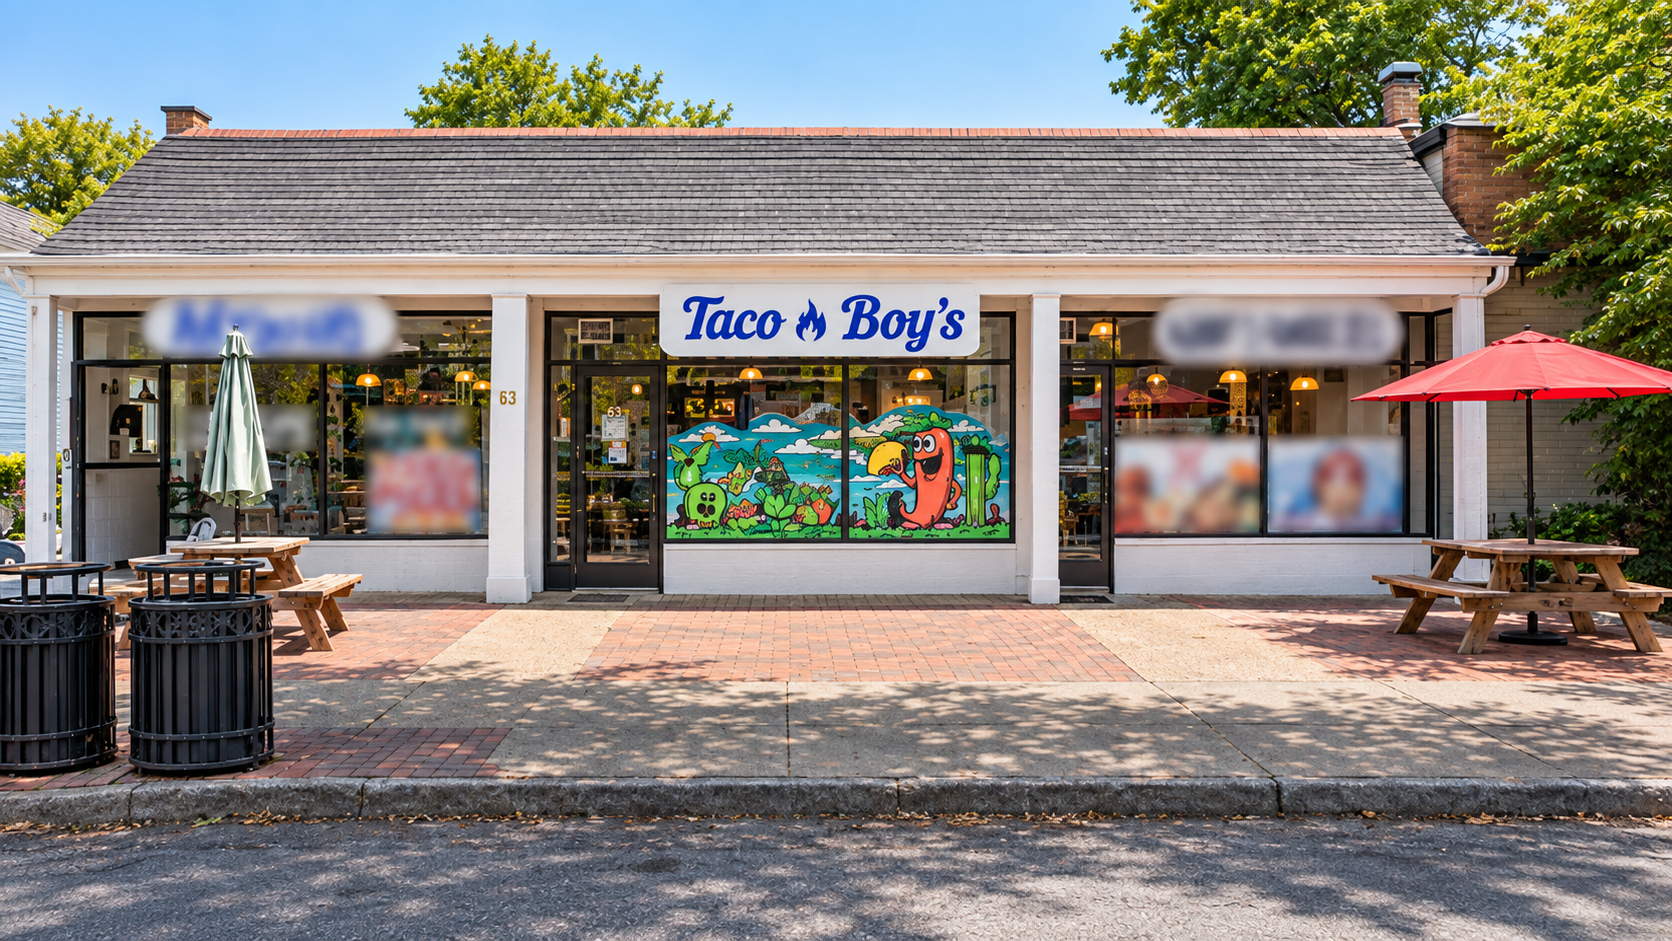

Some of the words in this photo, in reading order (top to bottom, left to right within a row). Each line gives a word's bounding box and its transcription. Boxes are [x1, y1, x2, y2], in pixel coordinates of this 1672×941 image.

[683, 295, 787, 341] Taco
[841, 294, 965, 353] Boy's
[500, 390, 516, 405] 63
[607, 406, 622, 418] 63
